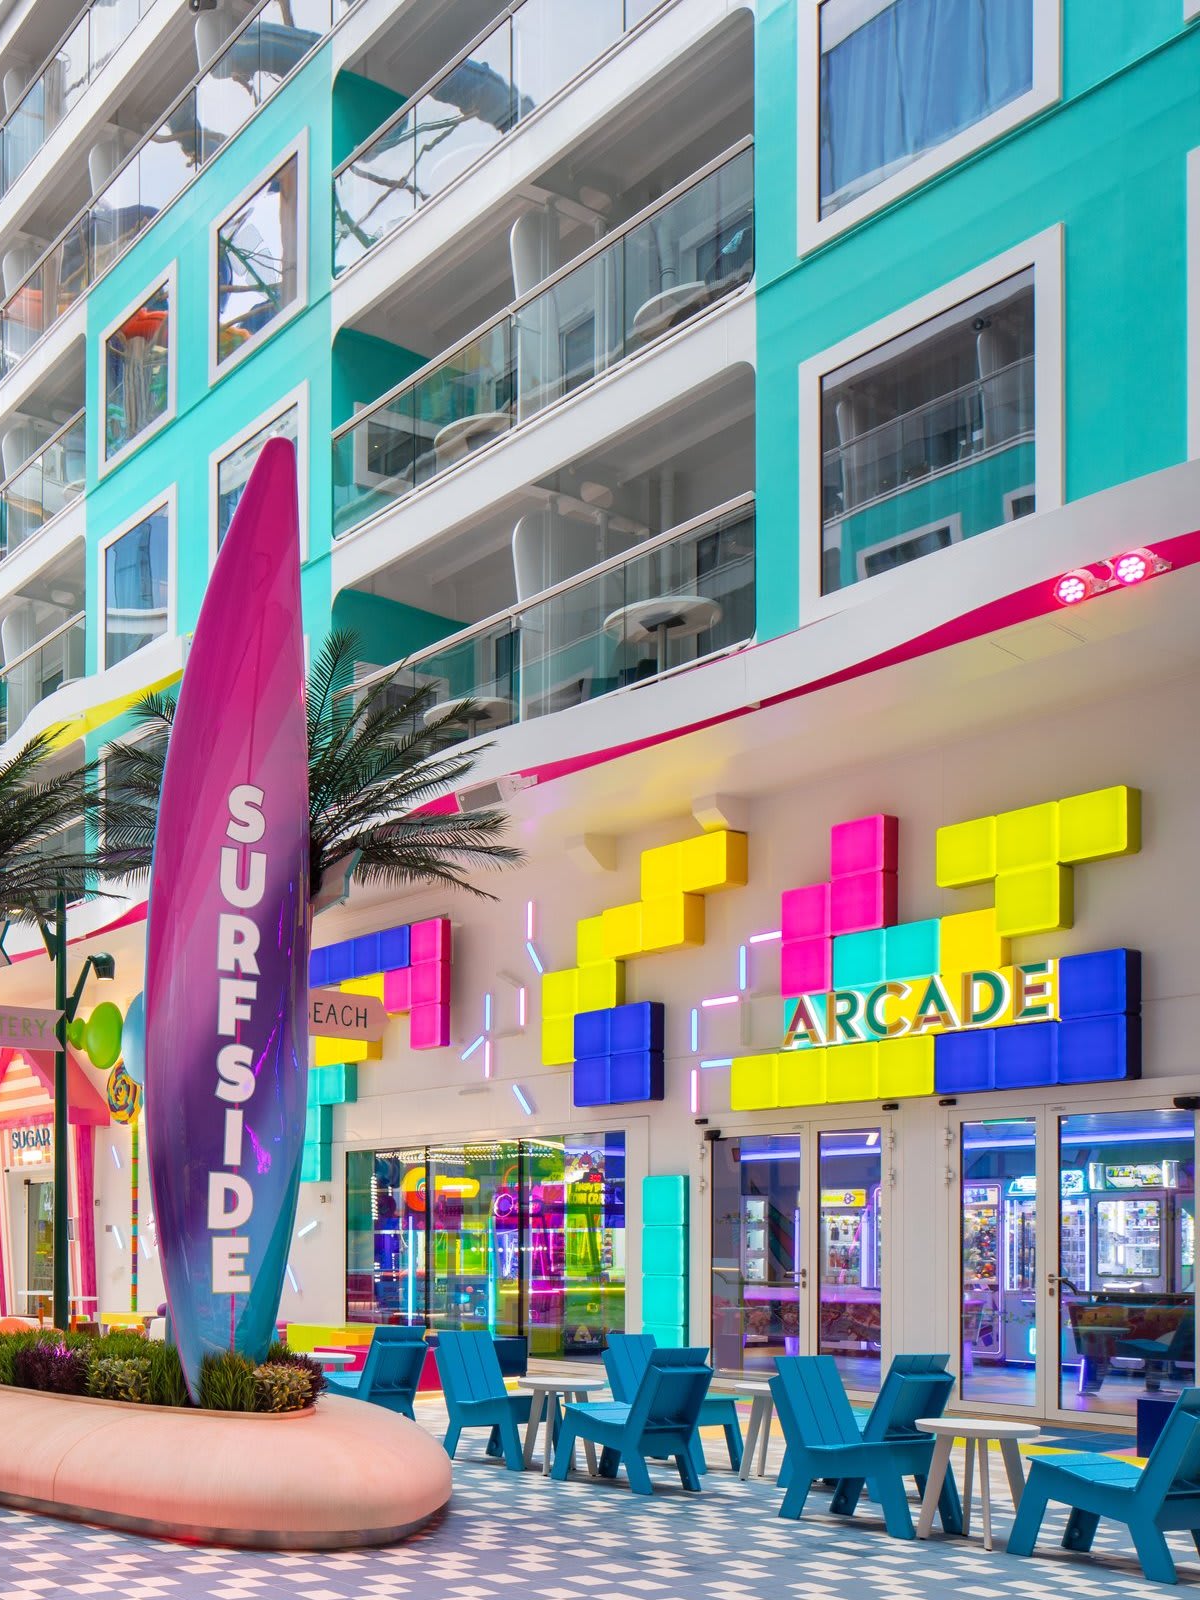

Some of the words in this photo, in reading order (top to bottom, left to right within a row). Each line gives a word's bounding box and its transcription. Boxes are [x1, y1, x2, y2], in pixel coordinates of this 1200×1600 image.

[309, 1002, 368, 1029] EACH
[782, 959, 1054, 1049] ARCADE
[207, 783, 267, 1295] SURFSIDE
[11, 1127, 52, 1150] SUGAR
